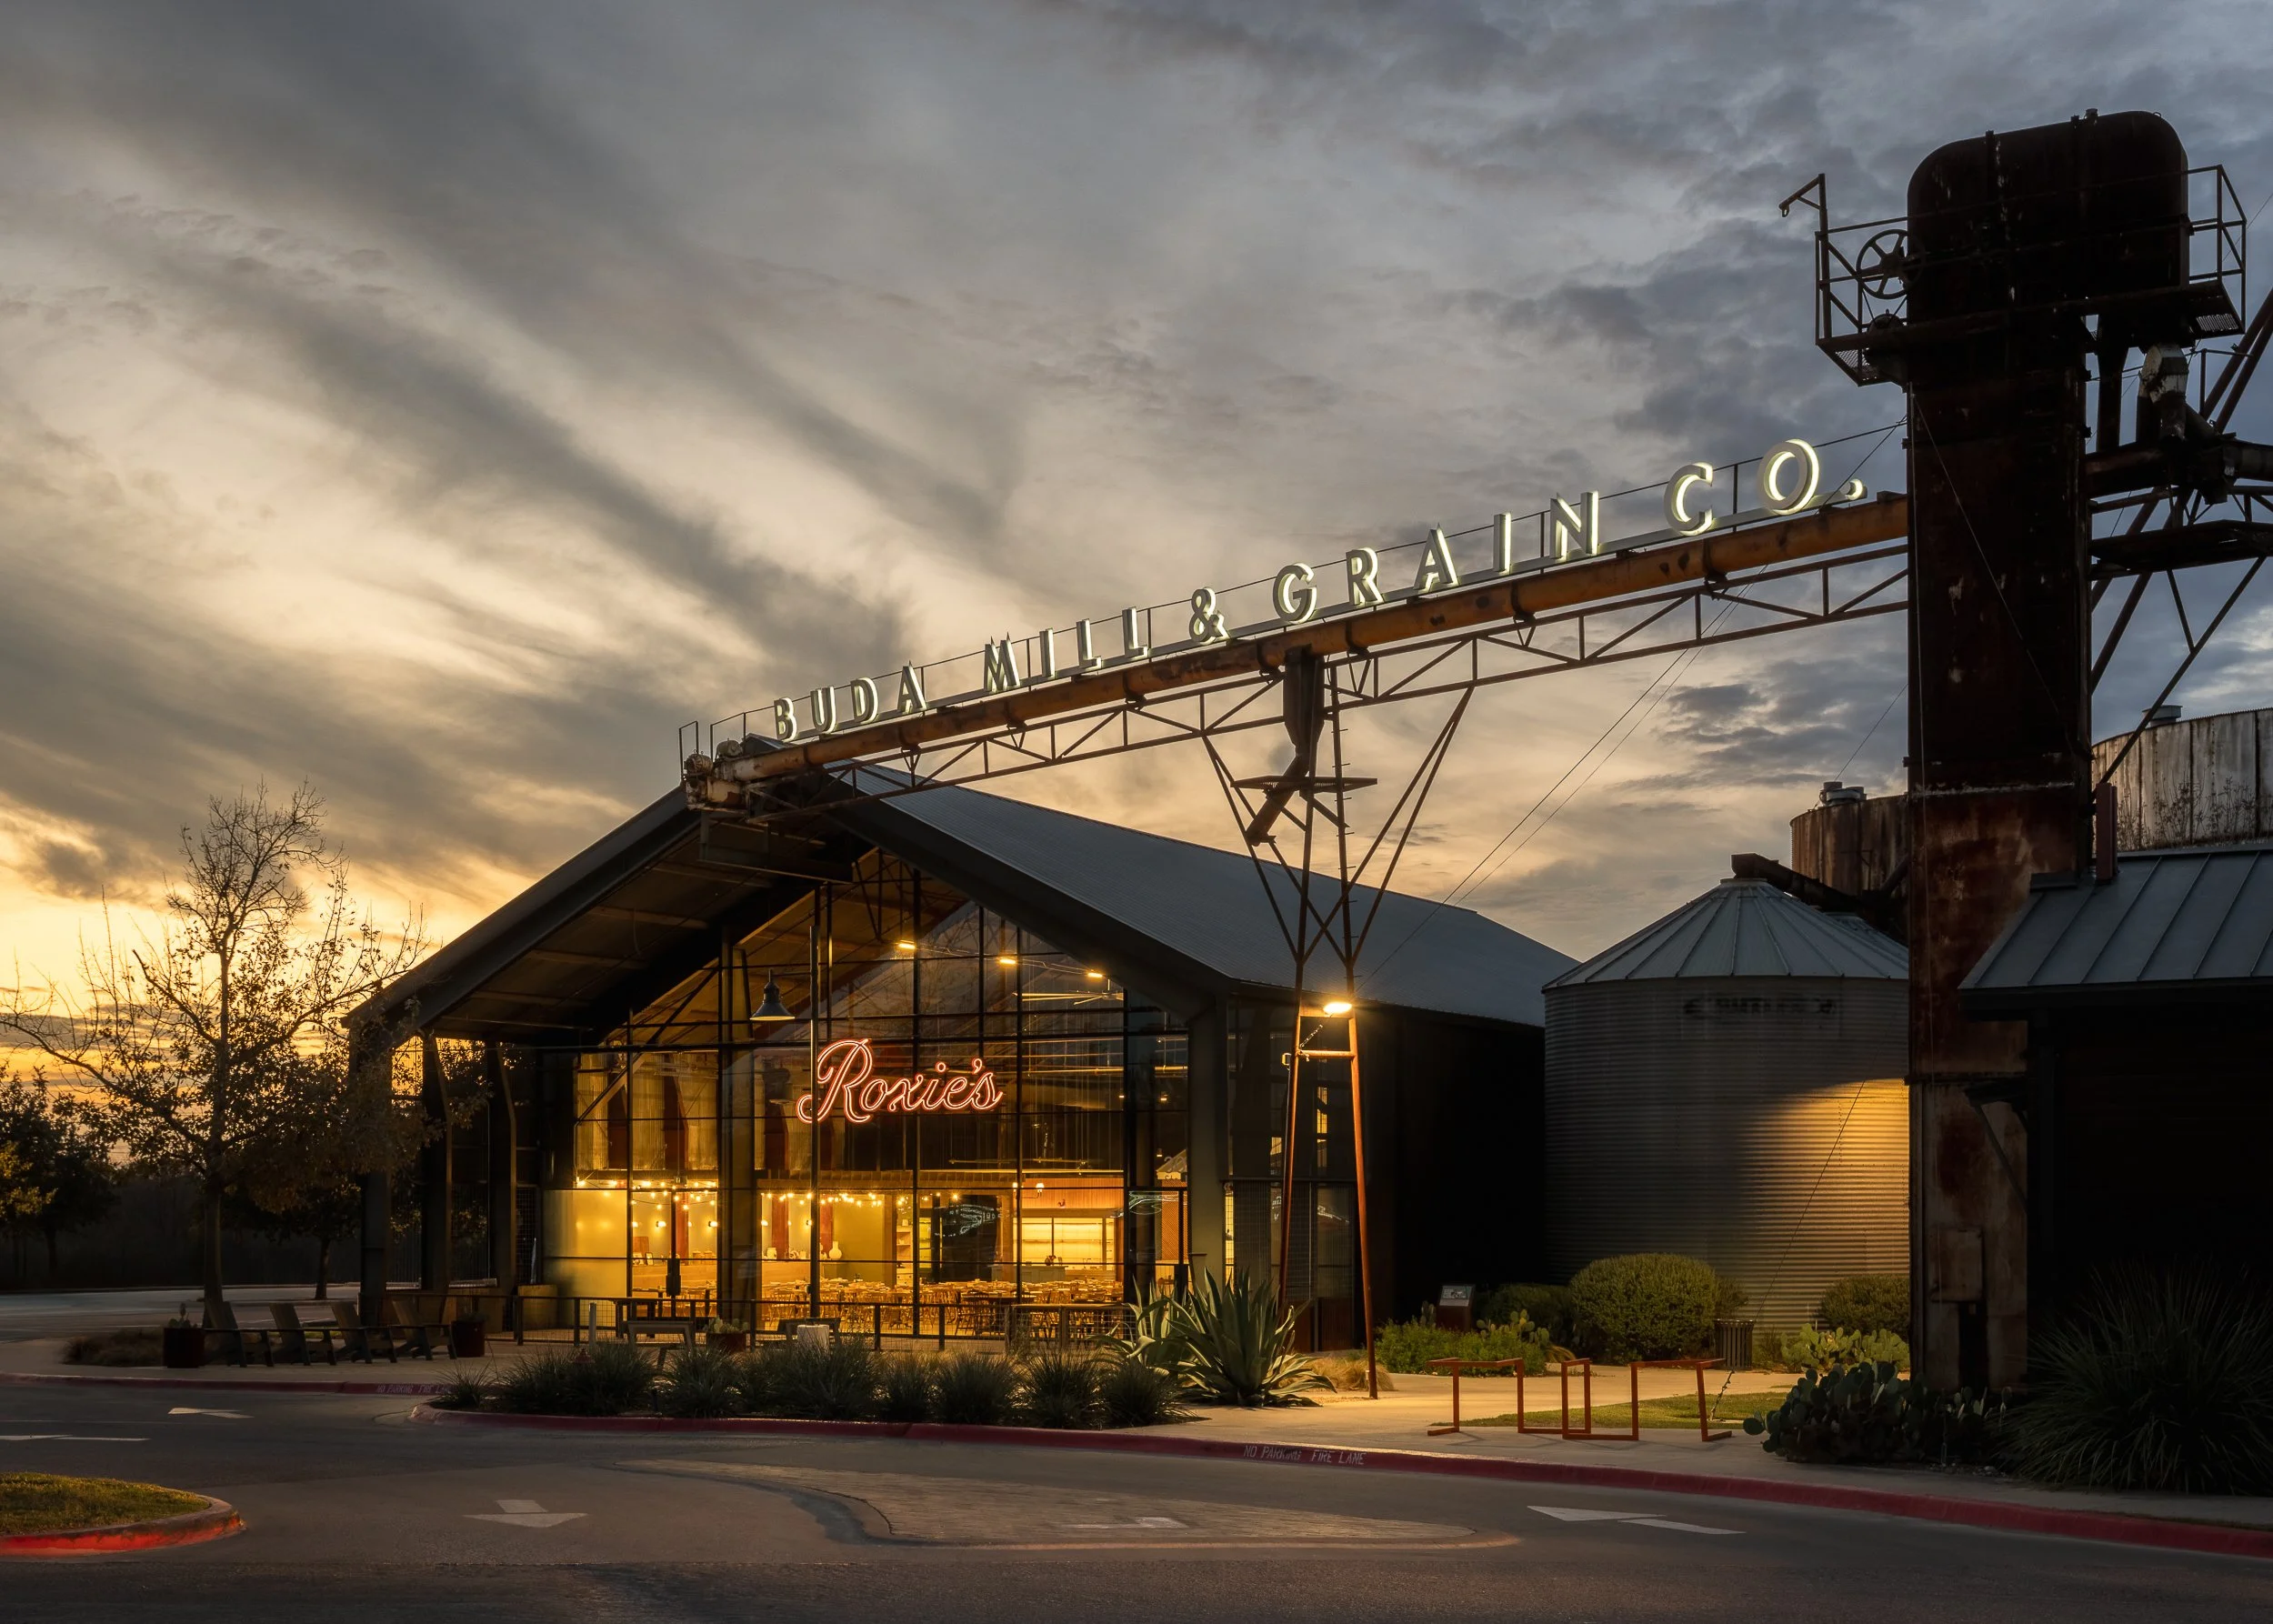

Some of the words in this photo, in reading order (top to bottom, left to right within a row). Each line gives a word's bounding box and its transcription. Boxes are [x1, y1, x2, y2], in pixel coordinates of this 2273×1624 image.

[774, 659, 927, 743] BUDA
[983, 605, 1149, 692] MILL
[1188, 586, 1229, 645] &
[1273, 489, 1599, 625] GRAIN
[1663, 438, 1867, 536] CO.
[796, 1038, 1004, 1123] Roxie's
[1243, 1445, 1257, 1458] NO
[1310, 1449, 1336, 1463] FIRE
[1338, 1451, 1367, 1465] LANE
